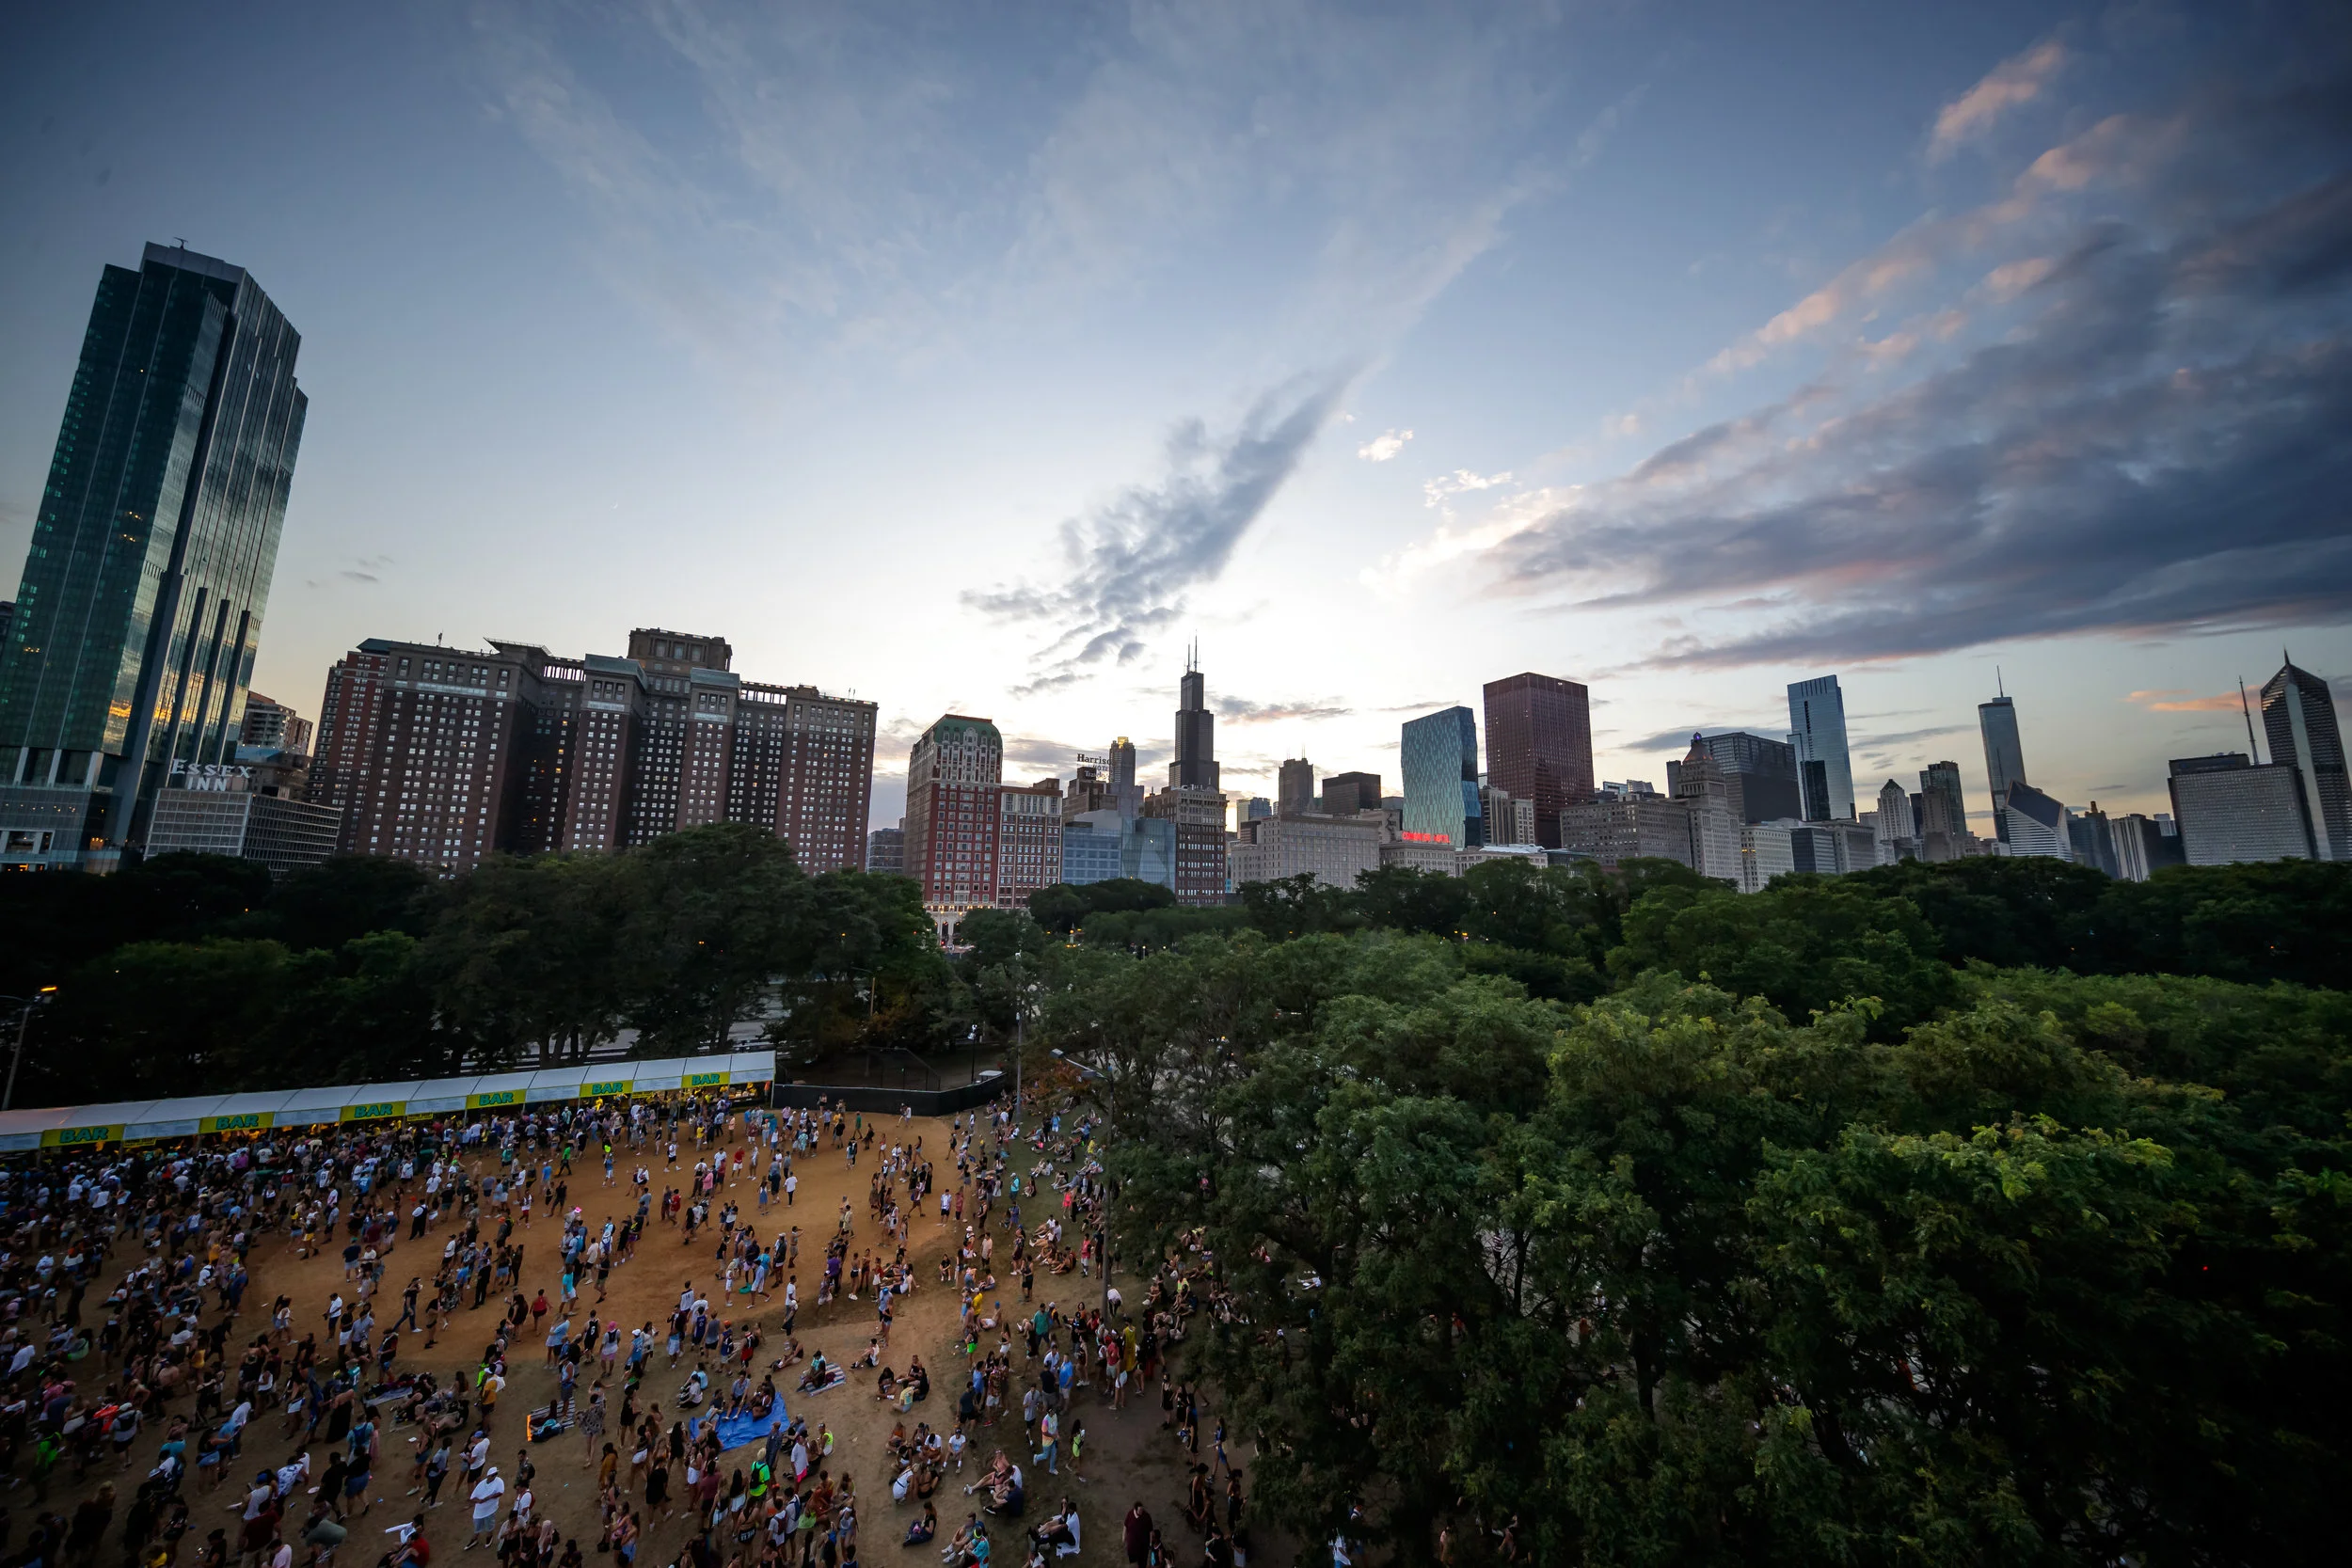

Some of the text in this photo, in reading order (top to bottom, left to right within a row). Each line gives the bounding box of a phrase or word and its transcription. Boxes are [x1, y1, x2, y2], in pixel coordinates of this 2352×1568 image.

[1076, 753, 1111, 765] Harriso
[187, 776, 228, 791] INN
[691, 1074, 721, 1086] BAR
[592, 1083, 623, 1095] BAR
[479, 1092, 513, 1105] BAR
[354, 1103, 393, 1118] BAR
[215, 1115, 259, 1130] BAR
[60, 1127, 108, 1143] BAR
